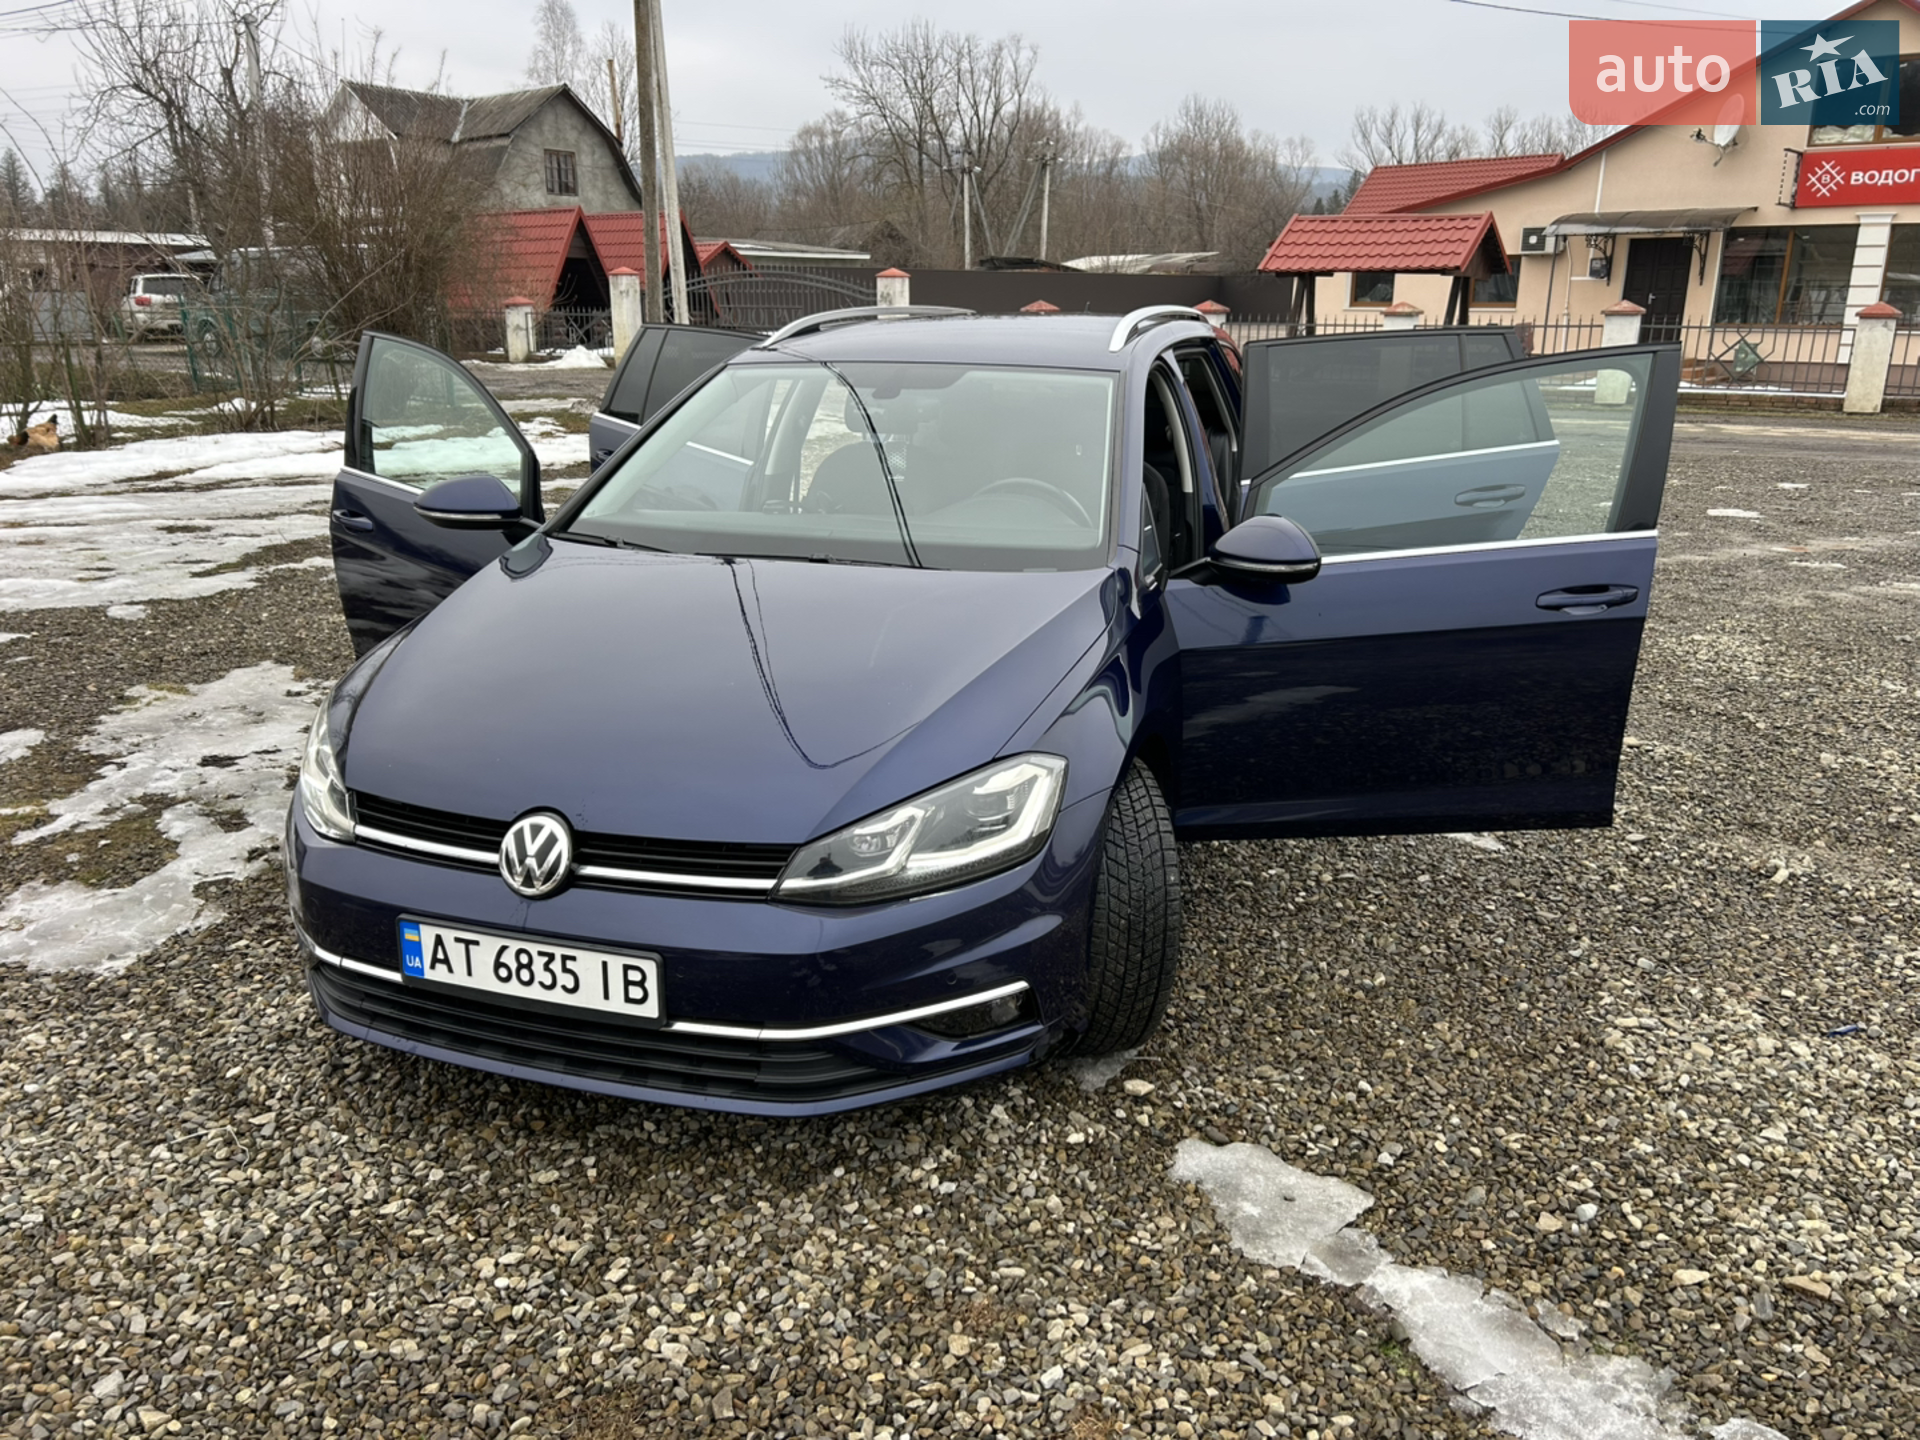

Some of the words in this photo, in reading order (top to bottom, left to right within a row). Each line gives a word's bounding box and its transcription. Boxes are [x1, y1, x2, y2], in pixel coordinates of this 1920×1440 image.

[405, 954, 422, 969] UA
[429, 933, 480, 978] AT
[492, 944, 580, 995] 6835
[601, 960, 650, 1005] IB
